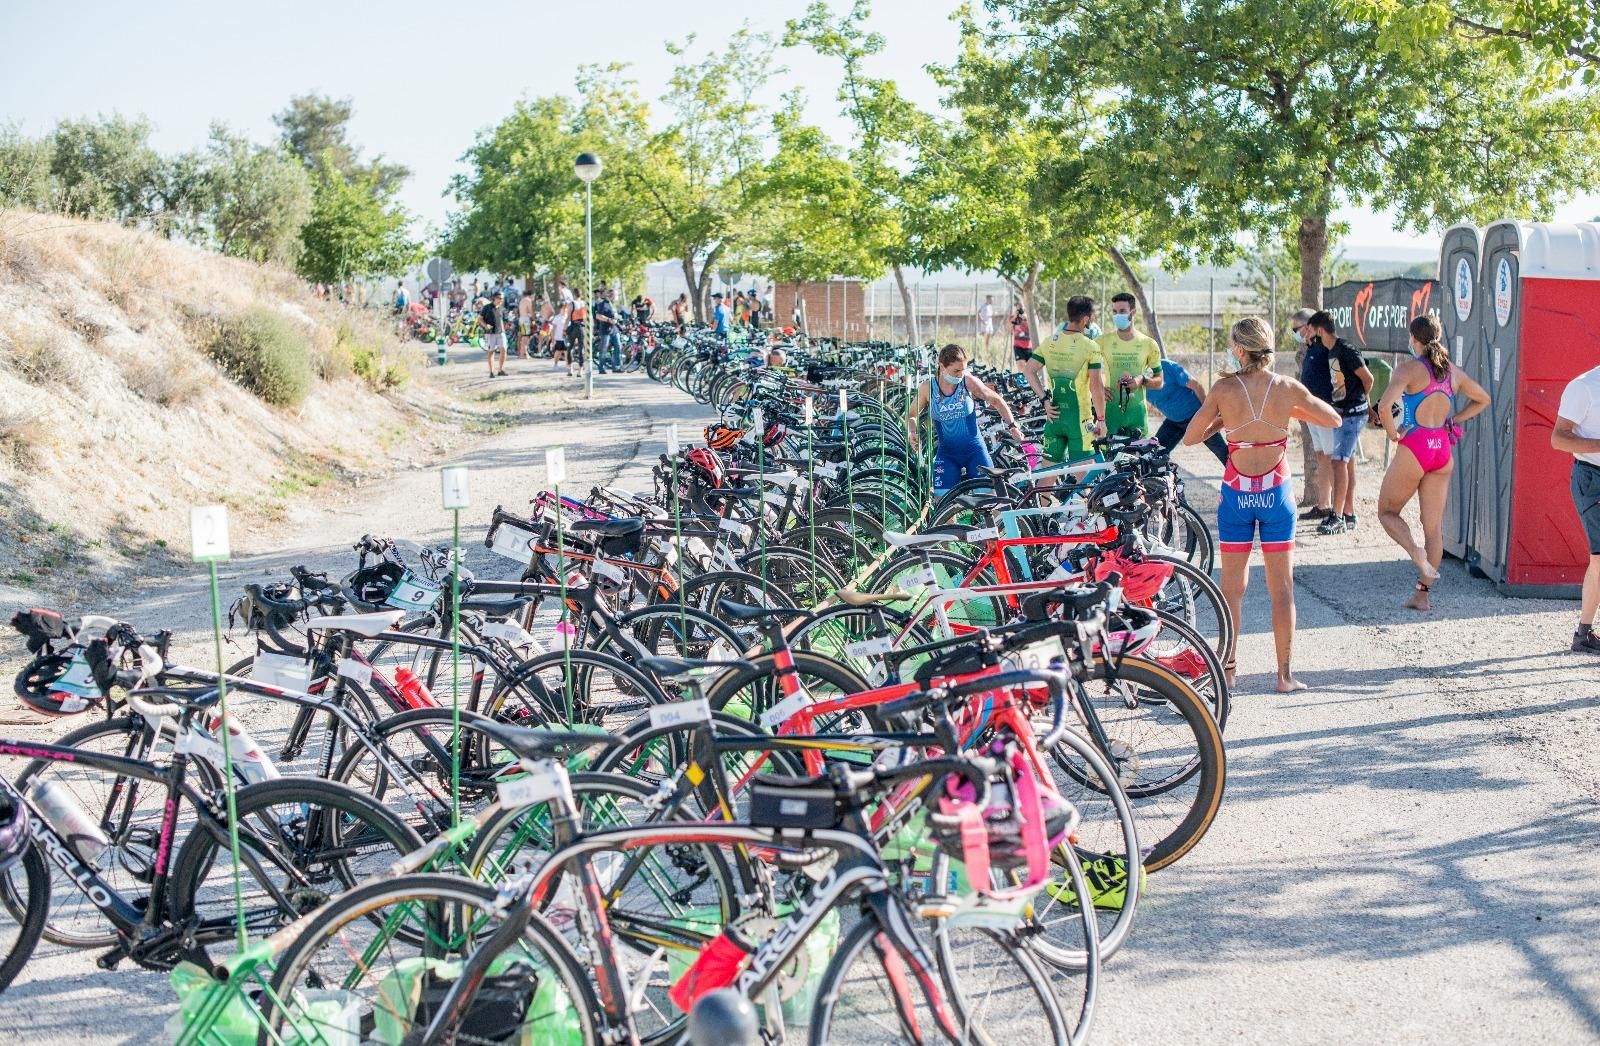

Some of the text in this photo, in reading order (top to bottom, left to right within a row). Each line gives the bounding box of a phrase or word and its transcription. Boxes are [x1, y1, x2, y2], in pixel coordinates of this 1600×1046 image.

[1237, 492, 1275, 509] NARANJO
[203, 514, 215, 546] 2
[411, 590, 425, 602] 9
[29, 818, 112, 908] ARELLO
[738, 867, 837, 1000] ARELLO
